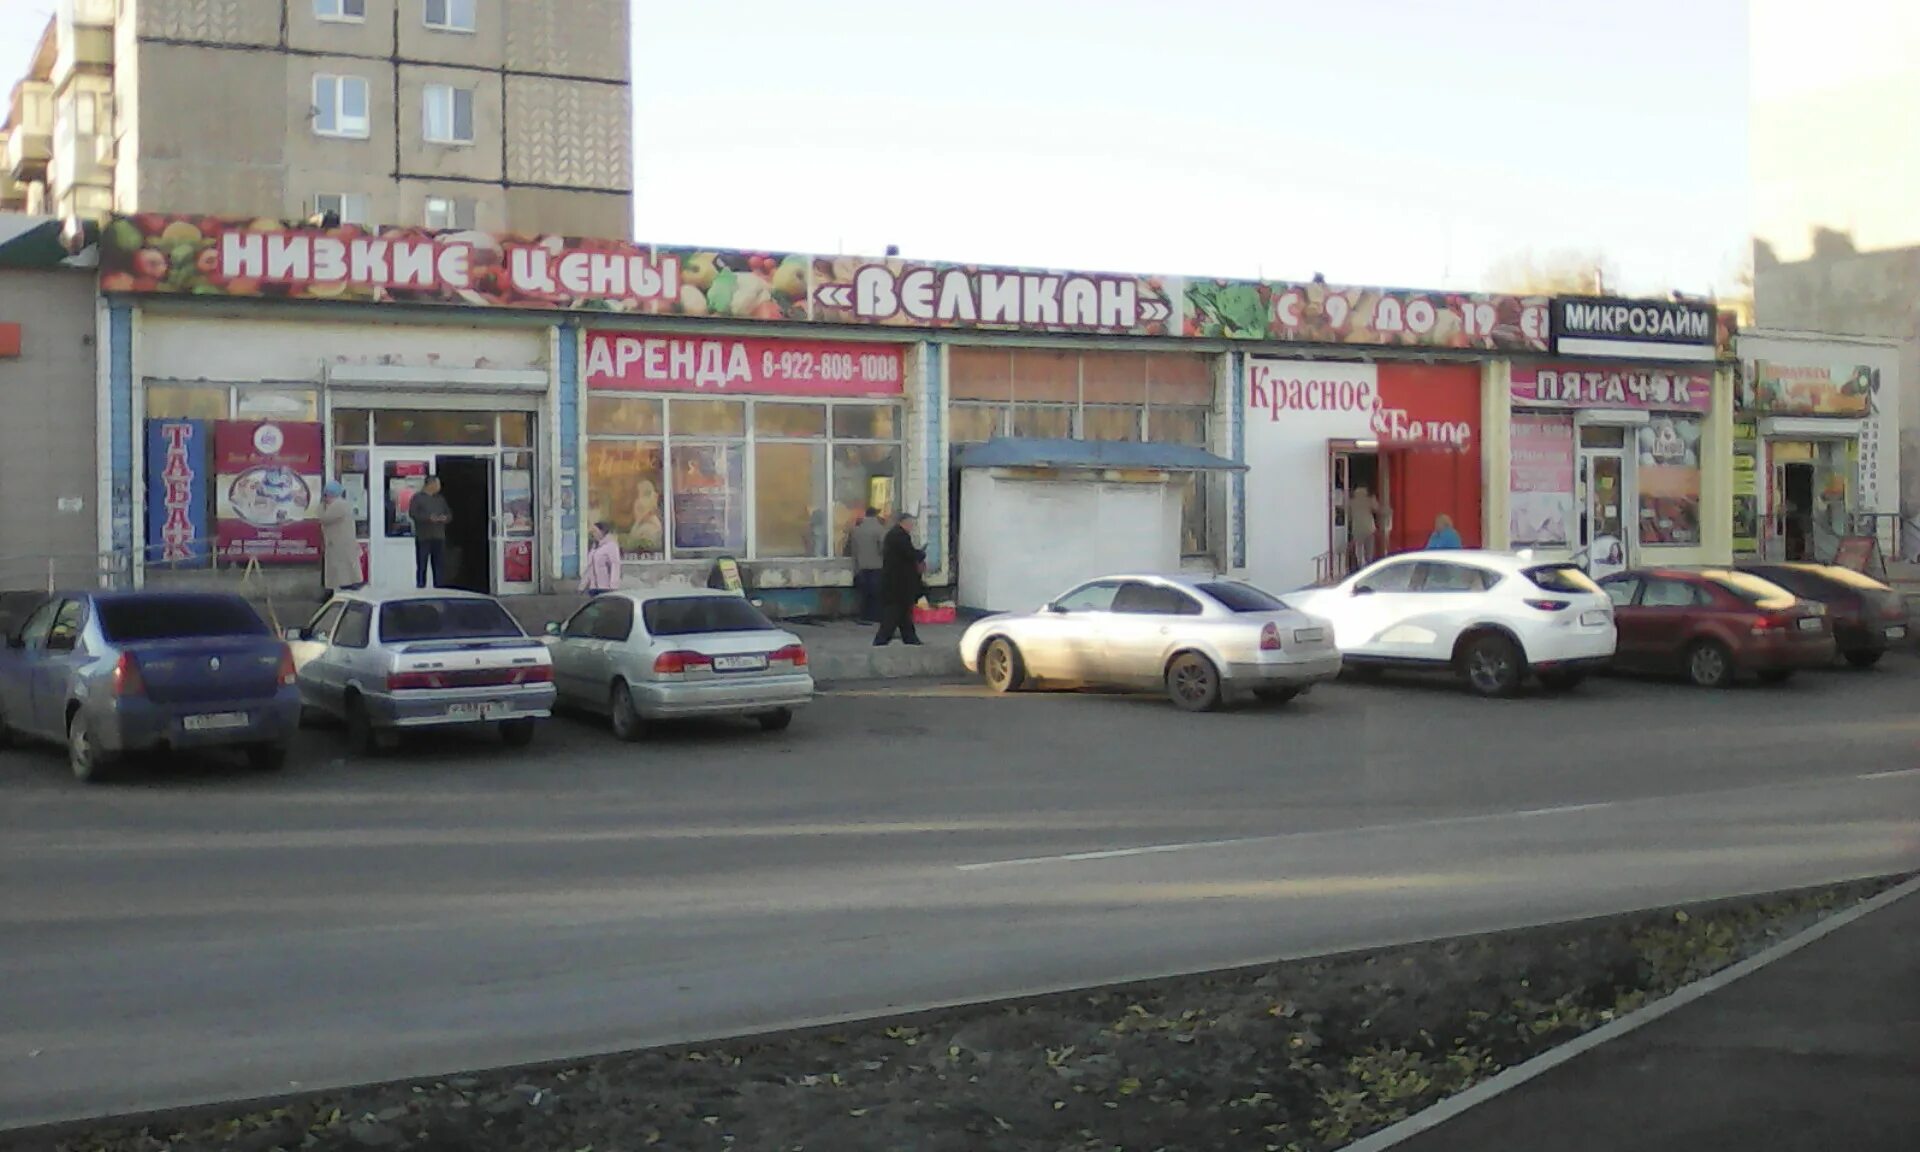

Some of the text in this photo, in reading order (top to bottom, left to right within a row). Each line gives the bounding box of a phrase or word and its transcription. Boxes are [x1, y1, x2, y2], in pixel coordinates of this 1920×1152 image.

[222, 232, 678, 299] НИЗКИЕ ЦЕНЫ
[817, 267, 1172, 327] «ВЕЛИКАН»
[1325, 297, 1348, 328] 9
[1462, 302, 1497, 337] 19
[1564, 303, 1709, 337] МИКРОЗАЙМ
[586, 337, 752, 387] АРЕНДА
[1249, 366, 1370, 420] Красное
[161, 424, 197, 561] ТАБАК
